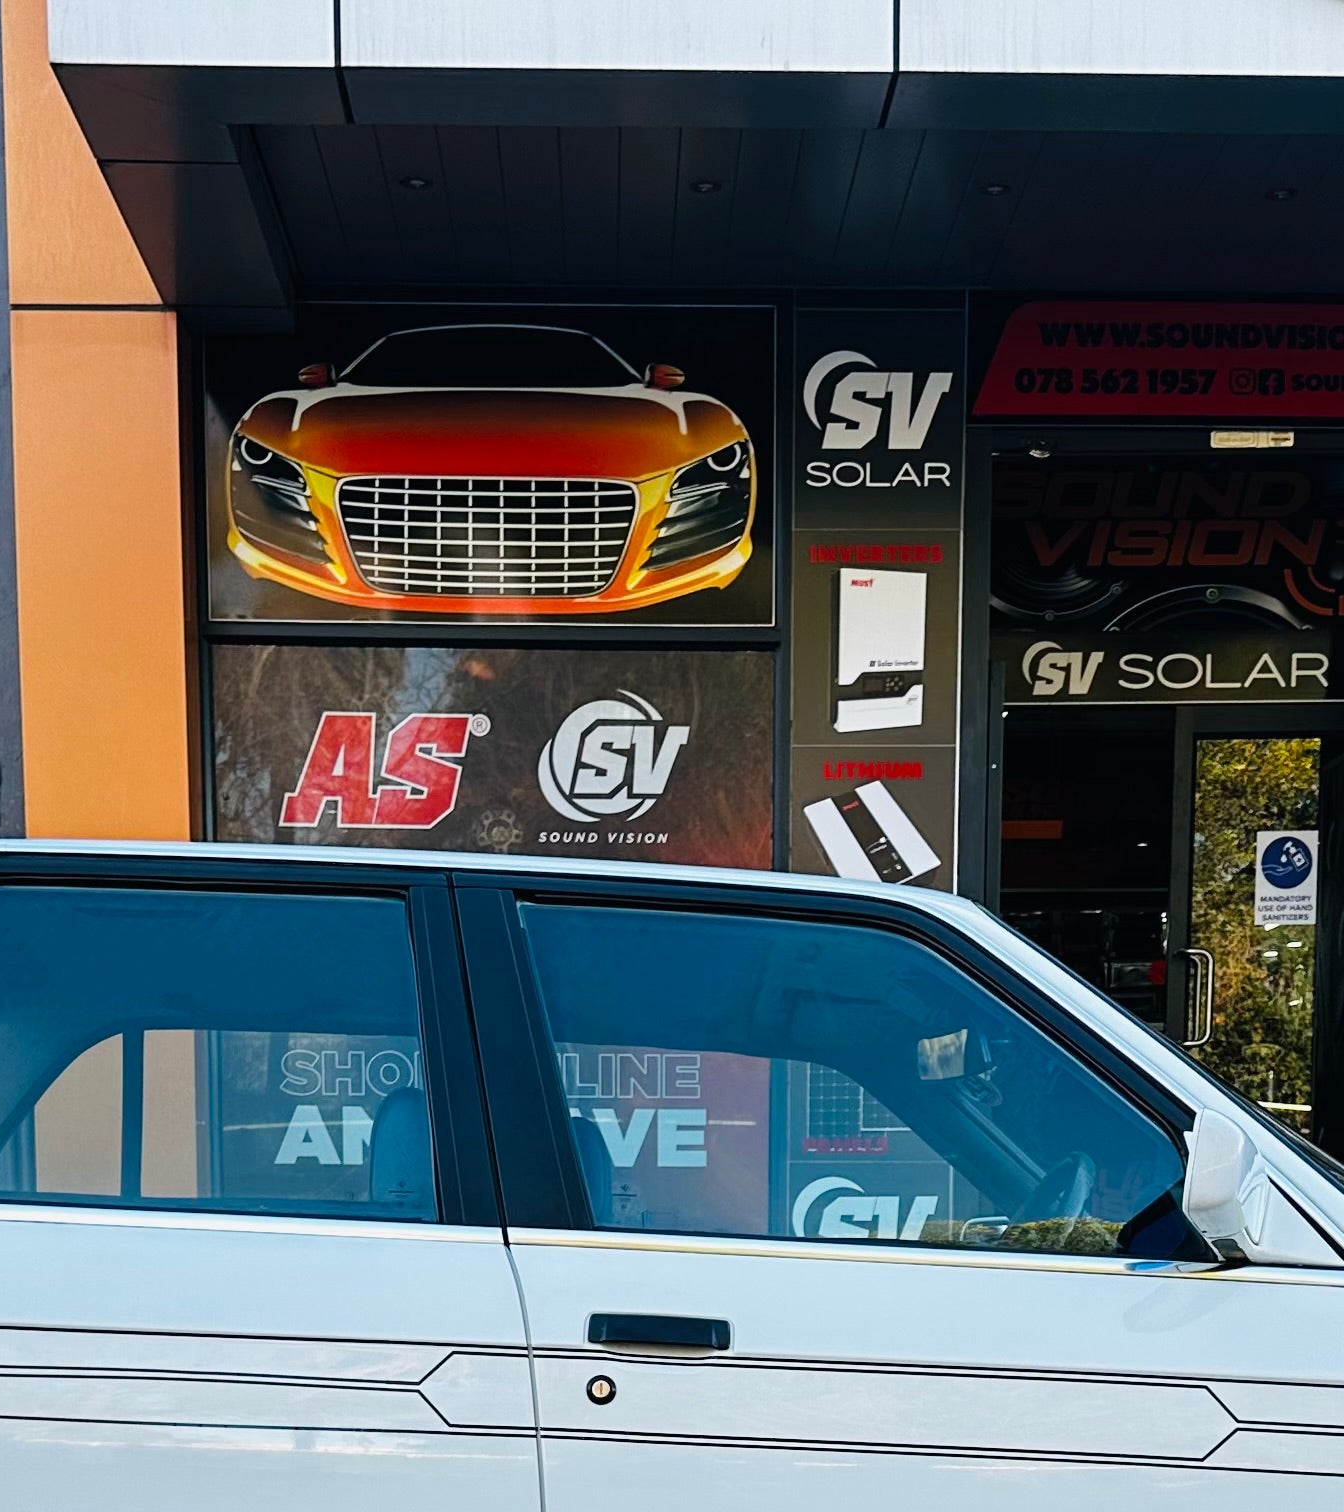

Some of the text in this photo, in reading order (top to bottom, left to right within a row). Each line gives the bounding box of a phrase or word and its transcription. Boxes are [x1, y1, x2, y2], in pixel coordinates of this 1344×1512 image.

[1080, 368, 1140, 395] 562
[1147, 369, 1217, 395] 1957
[821, 371, 954, 450] SV
[806, 461, 951, 487] SOLAR
[1025, 519, 1327, 567] VISION
[1032, 650, 1330, 696] SV SOLAR
[823, 760, 923, 781] LITHIUM
[538, 831, 669, 845] SOUND VISION
[280, 1049, 701, 1098] SHO LINE
[273, 1104, 707, 1167] AN VE
